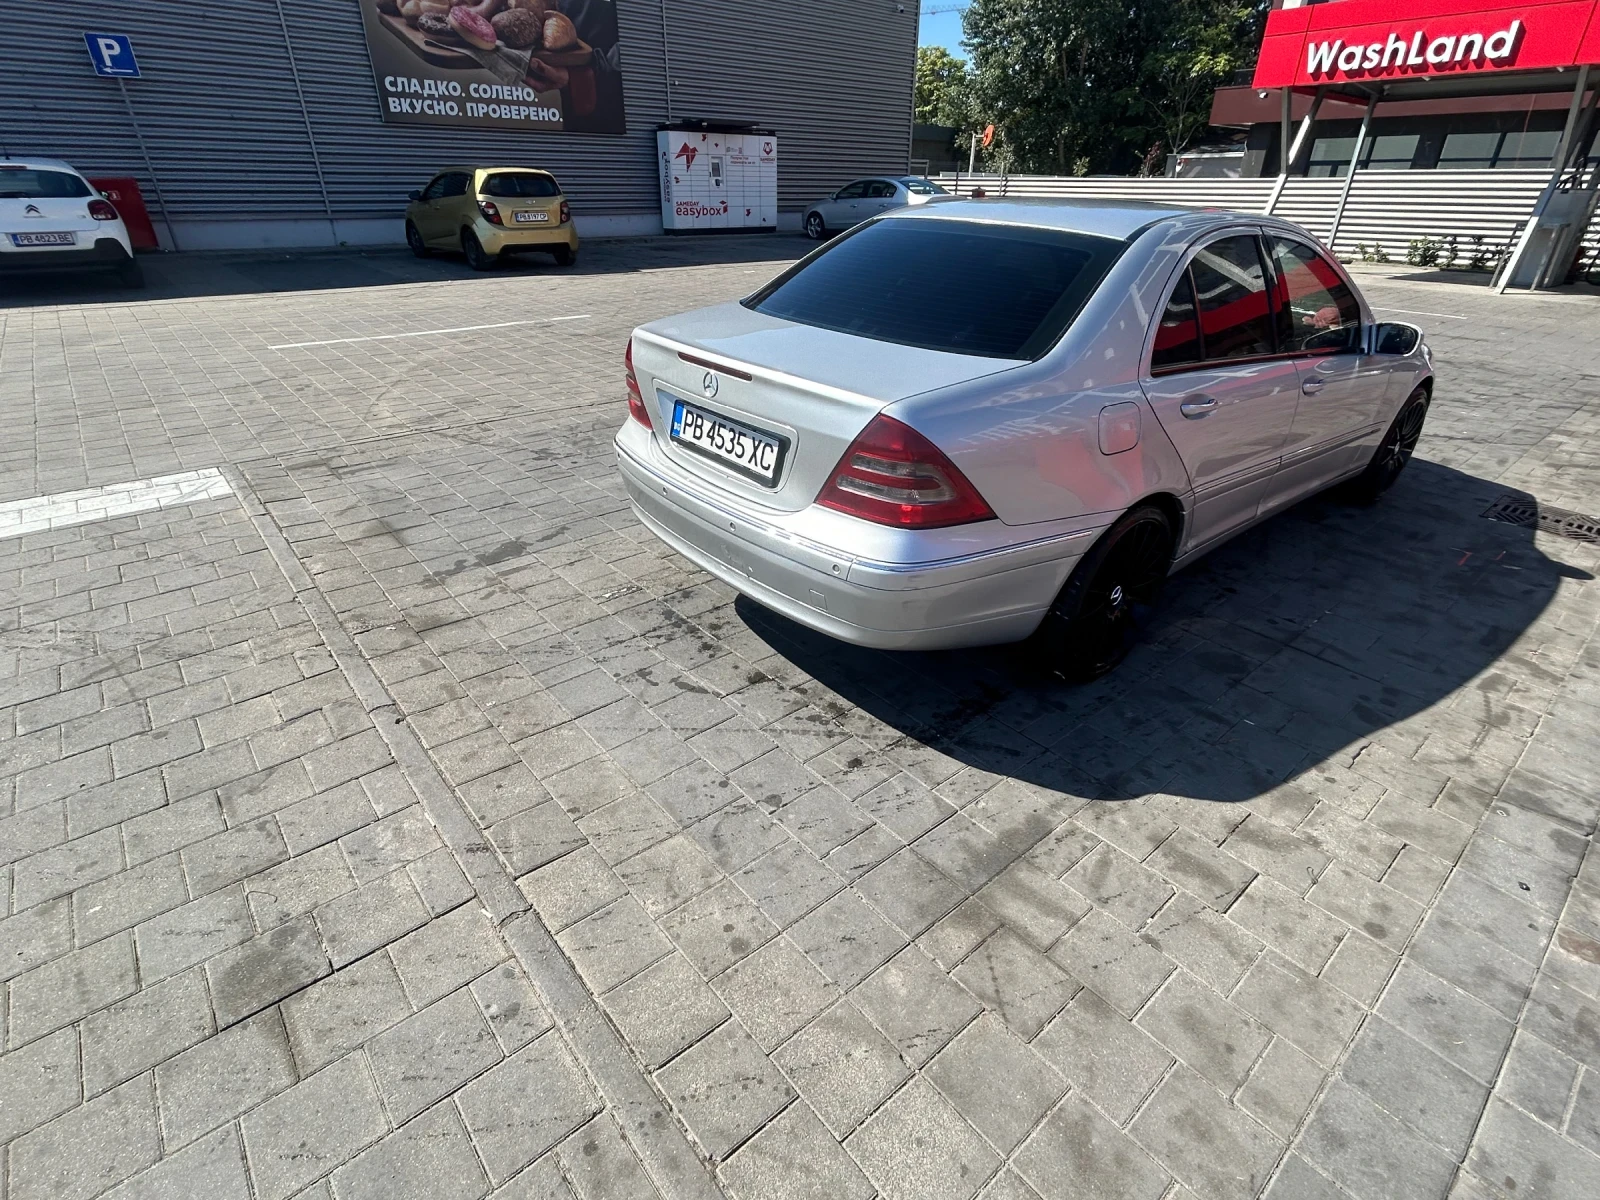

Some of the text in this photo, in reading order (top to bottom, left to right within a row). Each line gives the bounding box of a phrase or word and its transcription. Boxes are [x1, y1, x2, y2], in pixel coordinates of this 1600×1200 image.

[96, 38, 121, 66] P
[1306, 20, 1522, 74] WashLand
[384, 75, 539, 102] СЛАДКО. СОЛЕНО.
[388, 96, 564, 122] ВКУСНО. ПРОВЕРЕНО.
[675, 205, 721, 218] easybox
[19, 234, 72, 244] PB 4823 BE
[683, 410, 774, 471] PB 4535 XC
